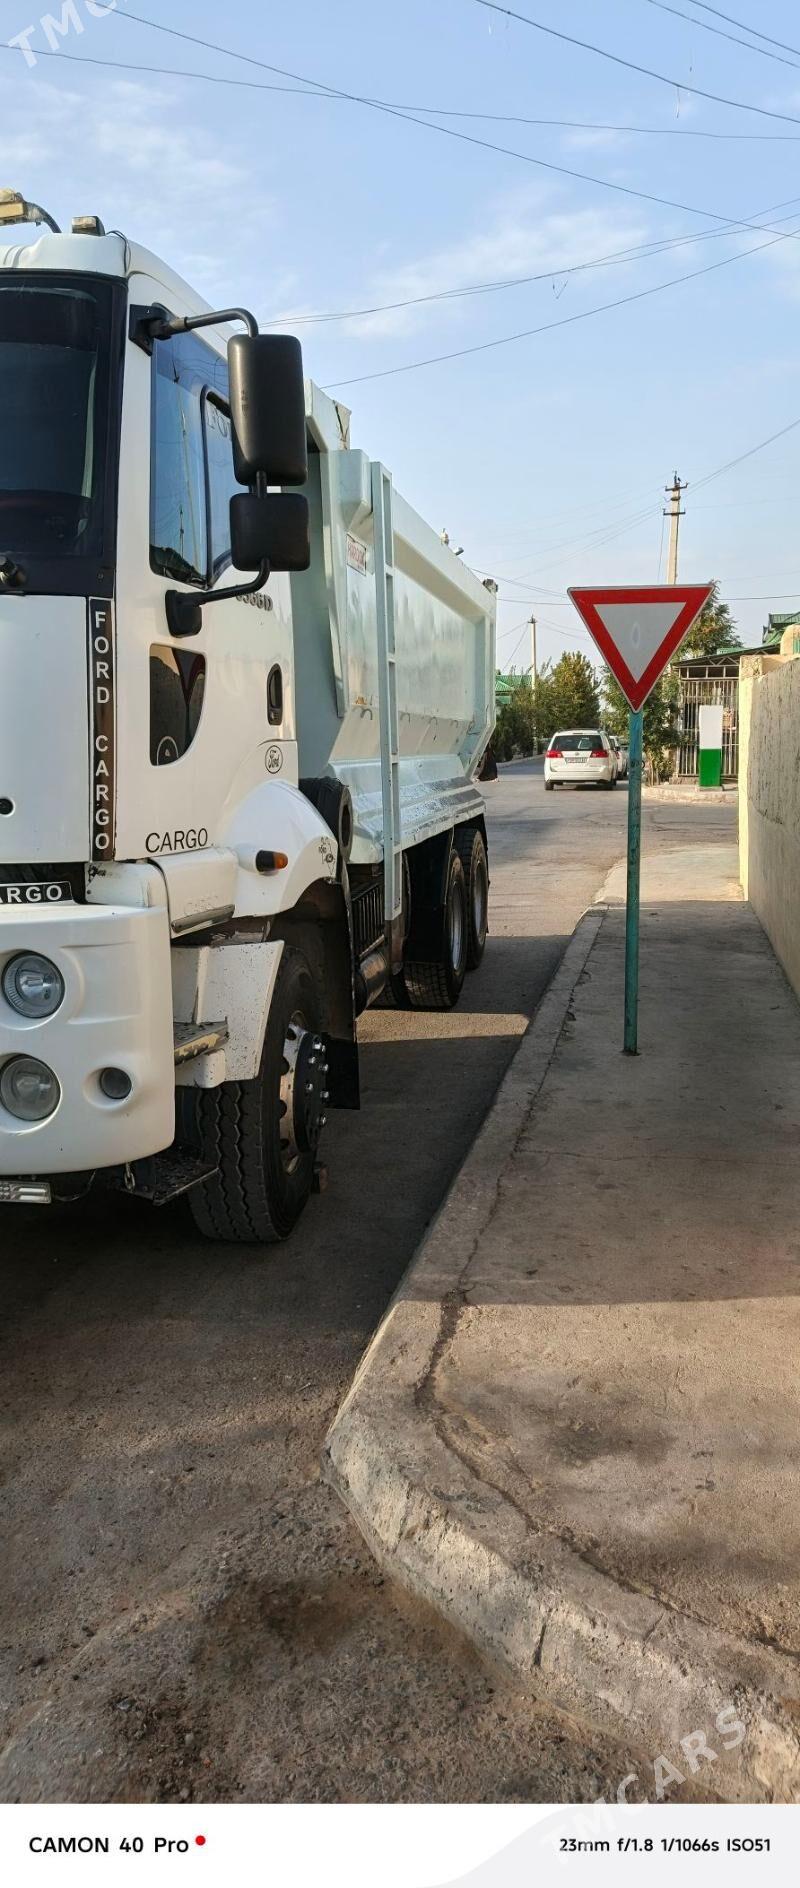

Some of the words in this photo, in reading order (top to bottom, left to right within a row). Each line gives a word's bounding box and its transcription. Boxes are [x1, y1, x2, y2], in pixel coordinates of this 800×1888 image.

[93, 610, 111, 705] FORD
[93, 734, 111, 851] CARGO
[145, 828, 208, 854] CARGO
[0, 884, 63, 904] RGO
